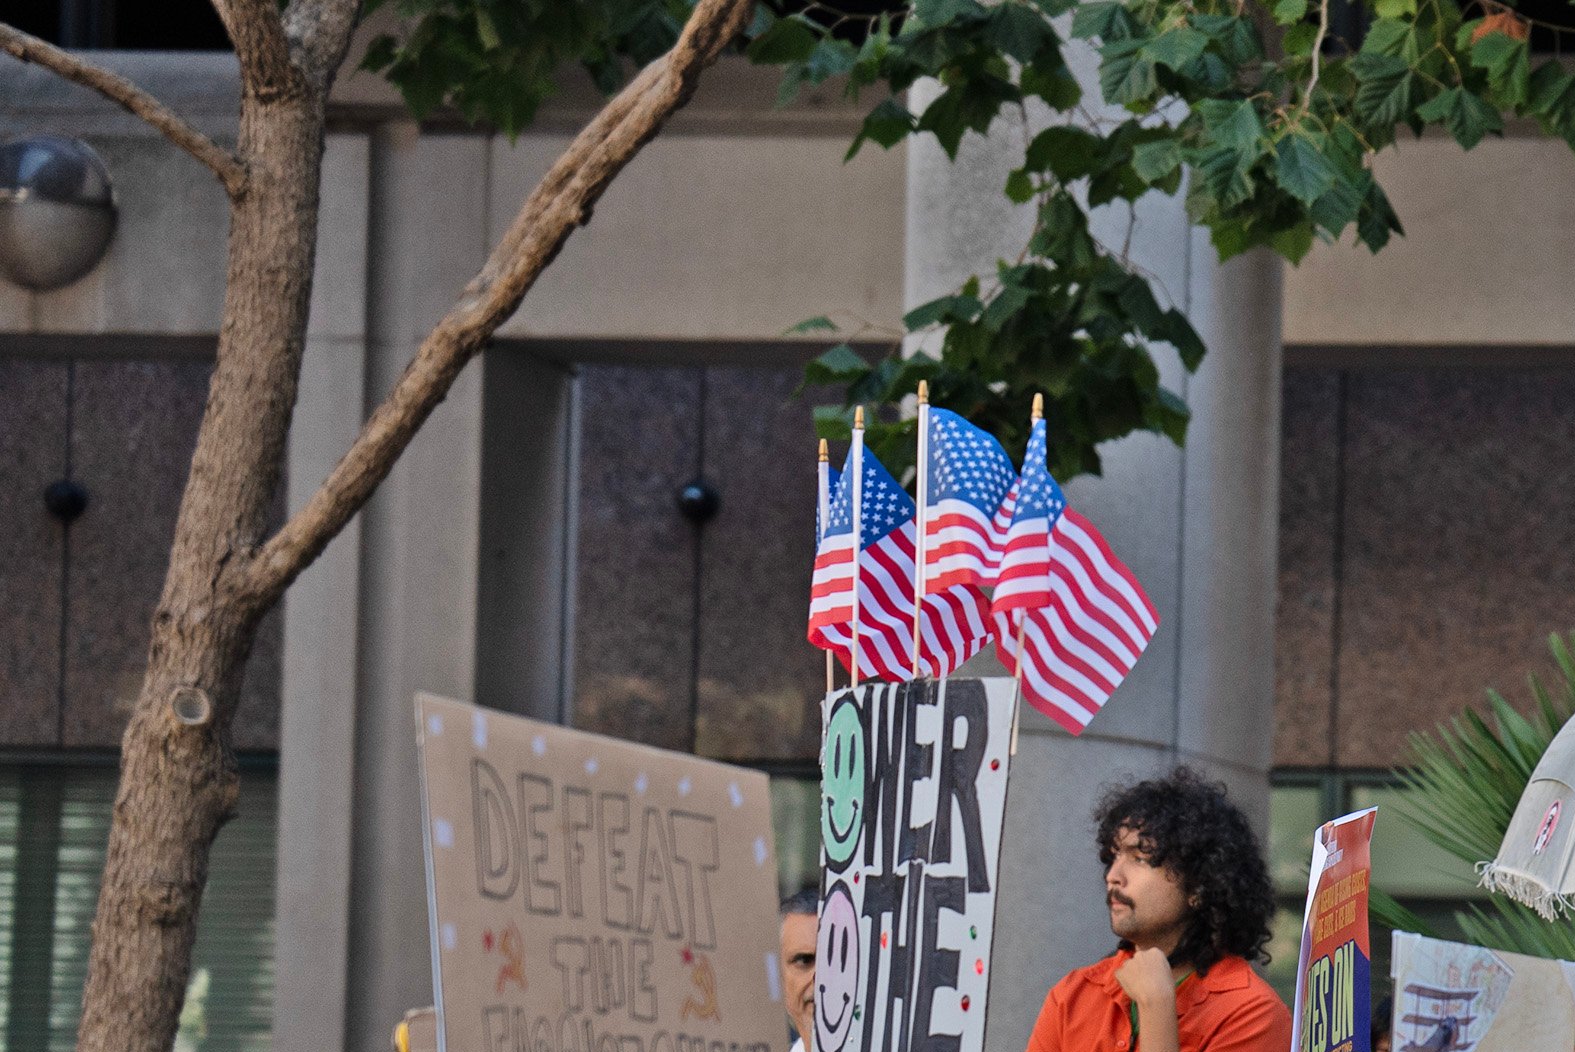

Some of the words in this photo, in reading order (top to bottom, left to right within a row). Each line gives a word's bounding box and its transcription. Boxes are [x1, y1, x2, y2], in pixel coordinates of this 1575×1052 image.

[469, 757, 720, 950] DEFEAT
[553, 934, 658, 1023] THE
[1331, 940, 1355, 1047] ON
